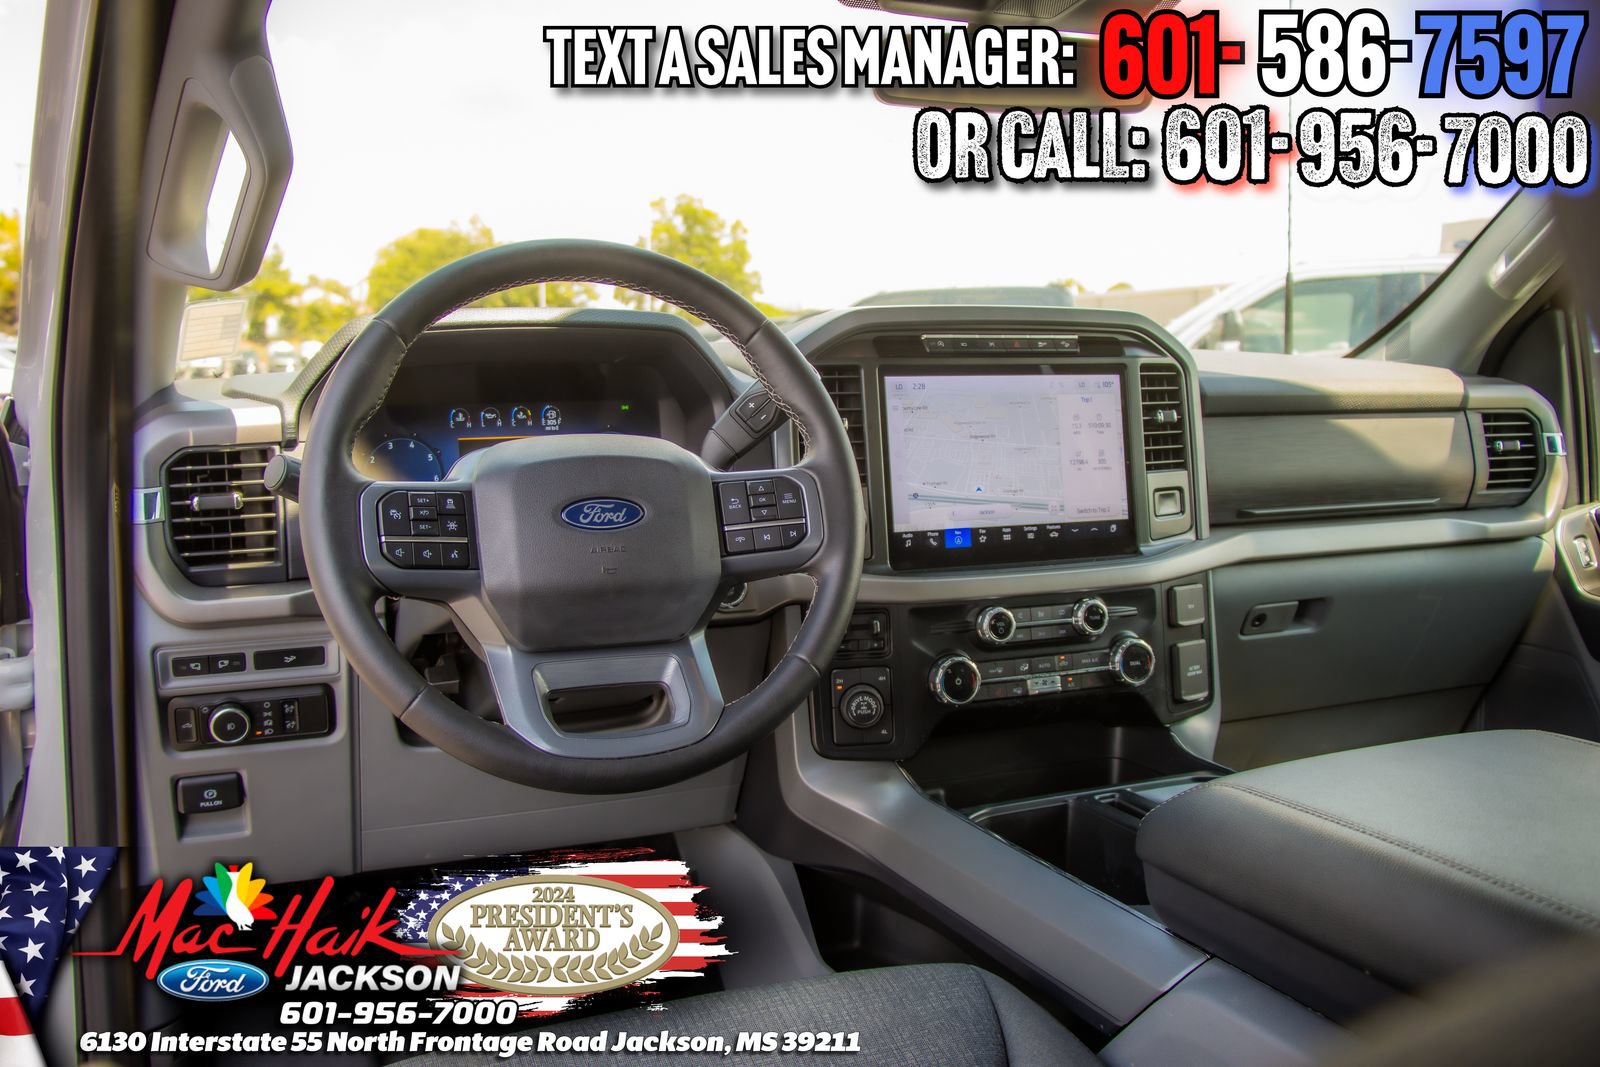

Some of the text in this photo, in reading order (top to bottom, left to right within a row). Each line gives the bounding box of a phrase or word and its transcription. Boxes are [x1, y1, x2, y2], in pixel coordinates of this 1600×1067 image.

[387, 442, 393, 450] 3
[409, 441, 415, 449] 4
[369, 456, 375, 464] 2
[427, 453, 433, 461] 5
[580, 503, 627, 524] Ford
